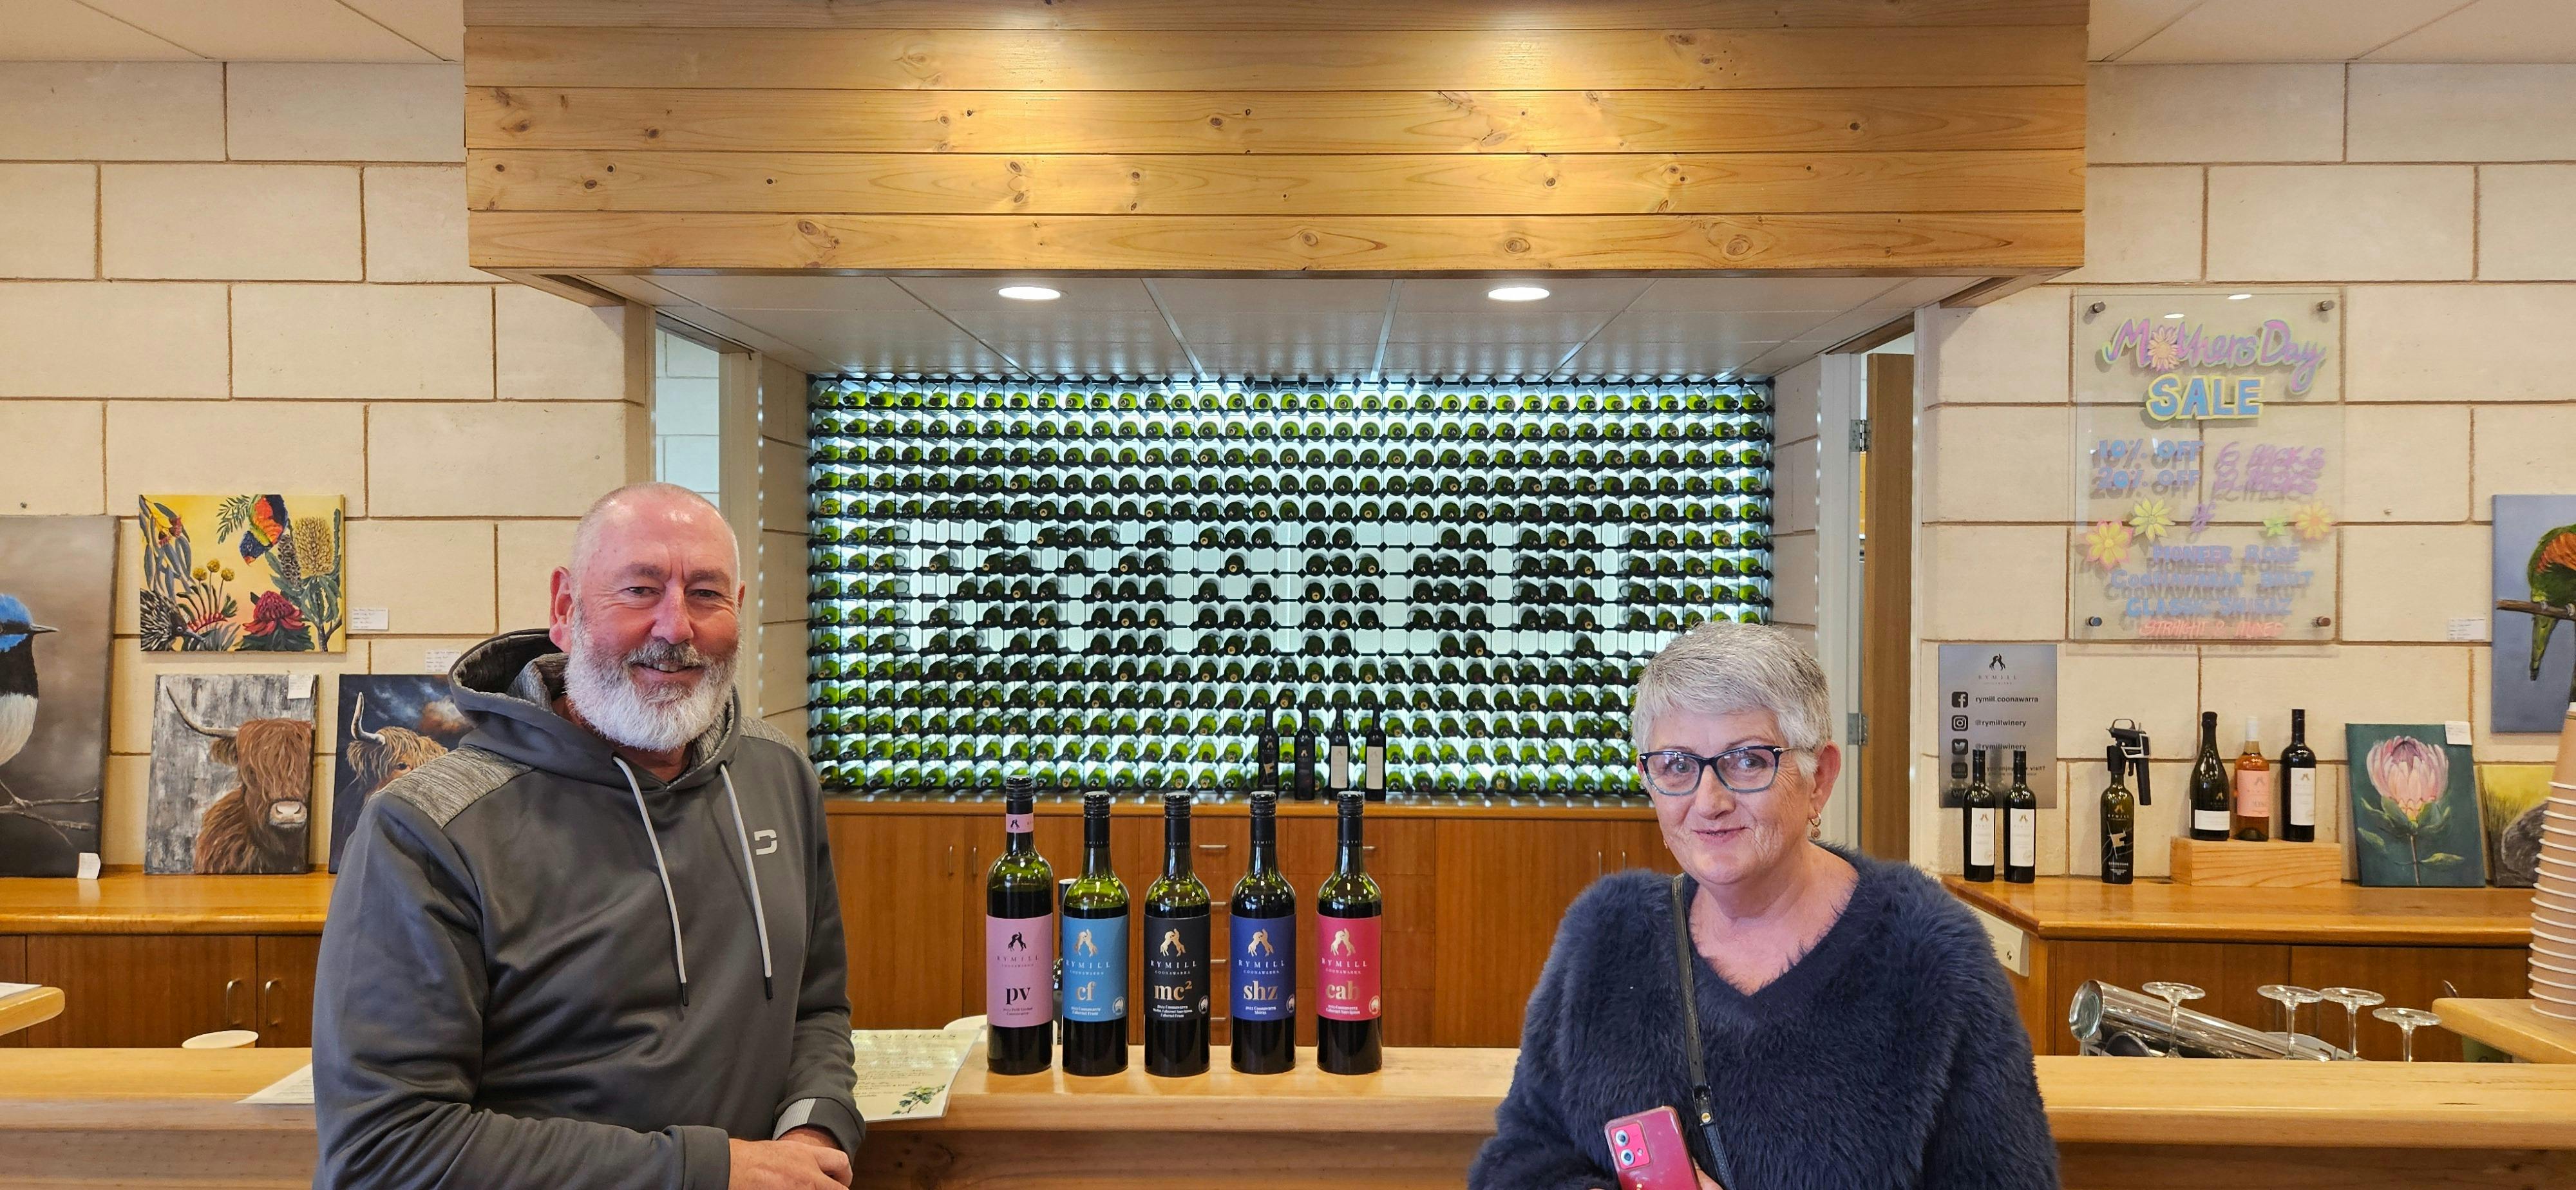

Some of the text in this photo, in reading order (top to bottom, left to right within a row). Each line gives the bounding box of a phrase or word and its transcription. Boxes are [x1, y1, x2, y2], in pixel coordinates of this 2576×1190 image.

[2257, 319, 2327, 395] Day
[2146, 374, 2264, 420] SALE
[2099, 439, 2205, 462] 10% OFF
[2098, 466, 2201, 489] 20% OFF
[2152, 545, 2233, 564] PIONEER
[1975, 695, 2038, 704] rymill.coonawarra
[1975, 719, 2027, 727] @rymillwinery
[1975, 742, 2027, 751] @rymillwinery
[1066, 959, 1110, 968] RYMILL
[1150, 959, 1197, 968] RYMILL
[1238, 959, 1285, 968] RYMILL
[1321, 958, 1367, 967] RYMILL
[1005, 987, 1030, 1005] pv
[1076, 981, 1097, 1001] cf
[1243, 980, 1278, 1001] shz
[1325, 979, 1361, 1001] cab
